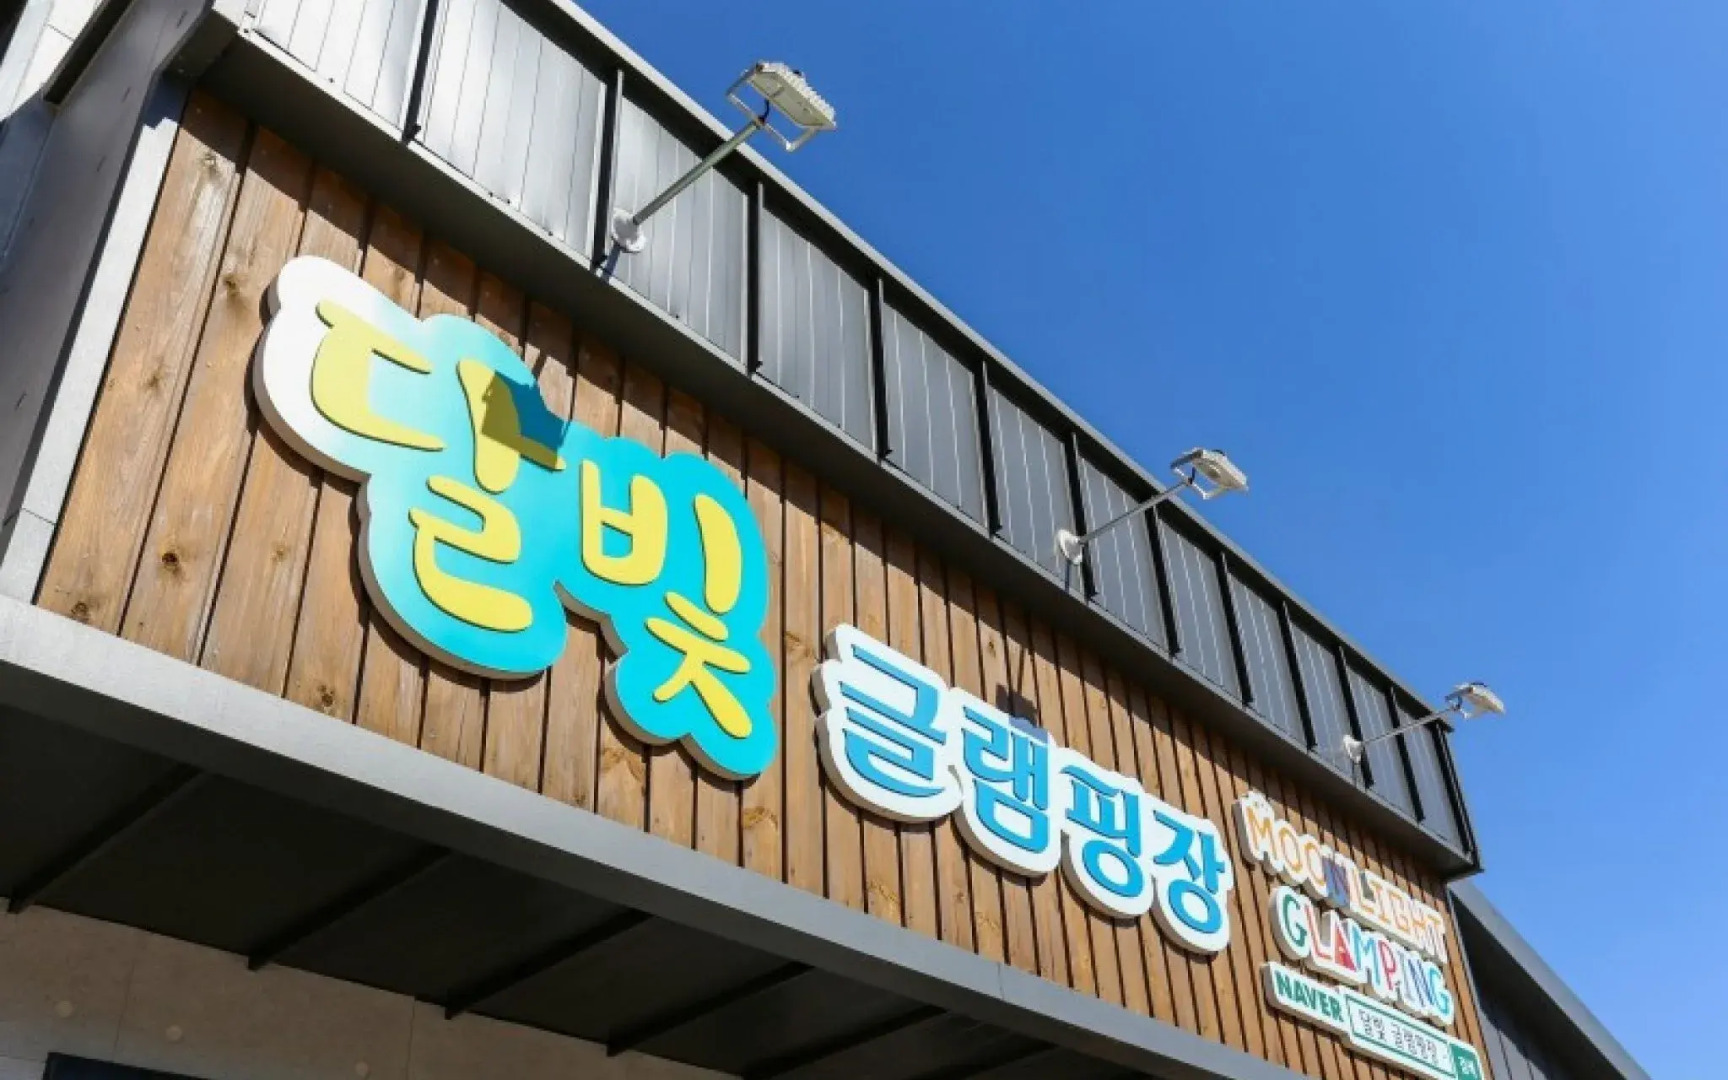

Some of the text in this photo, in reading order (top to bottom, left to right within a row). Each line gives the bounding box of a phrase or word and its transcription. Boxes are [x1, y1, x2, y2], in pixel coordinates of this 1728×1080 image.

[310, 299, 1226, 934] 달빛 글램핑장
[1275, 970, 1344, 1022] NAVER
[1282, 893, 1450, 1015] GLAMPING
